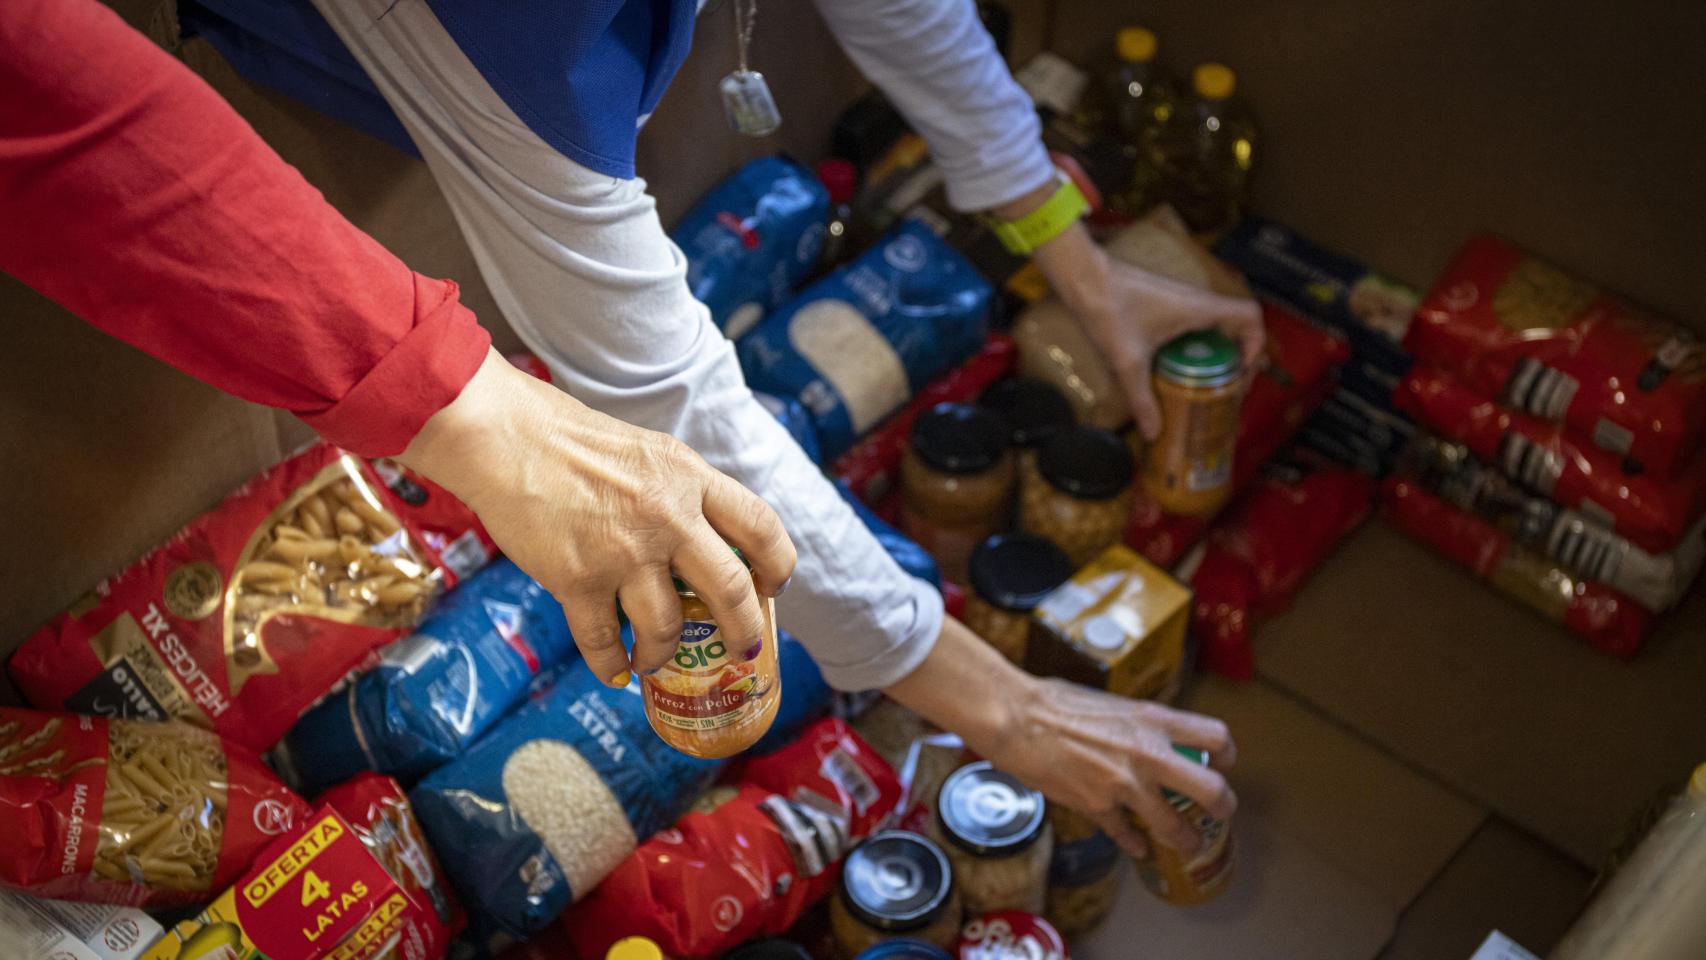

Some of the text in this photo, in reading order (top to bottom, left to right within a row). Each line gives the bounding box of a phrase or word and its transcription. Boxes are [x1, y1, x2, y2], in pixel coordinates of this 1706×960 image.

[141, 602, 170, 640] XL
[682, 626, 711, 636] ero
[159, 632, 231, 718] HÉLICES
[674, 641, 727, 669] olo
[654, 691, 686, 709] Arroz
[705, 693, 741, 711] Pollo
[568, 700, 626, 763] EXTRA
[61, 783, 88, 875] MACARRONS
[249, 822, 339, 900] OFERTA
[301, 869, 331, 907] 4
[302, 880, 368, 942] LATAS
